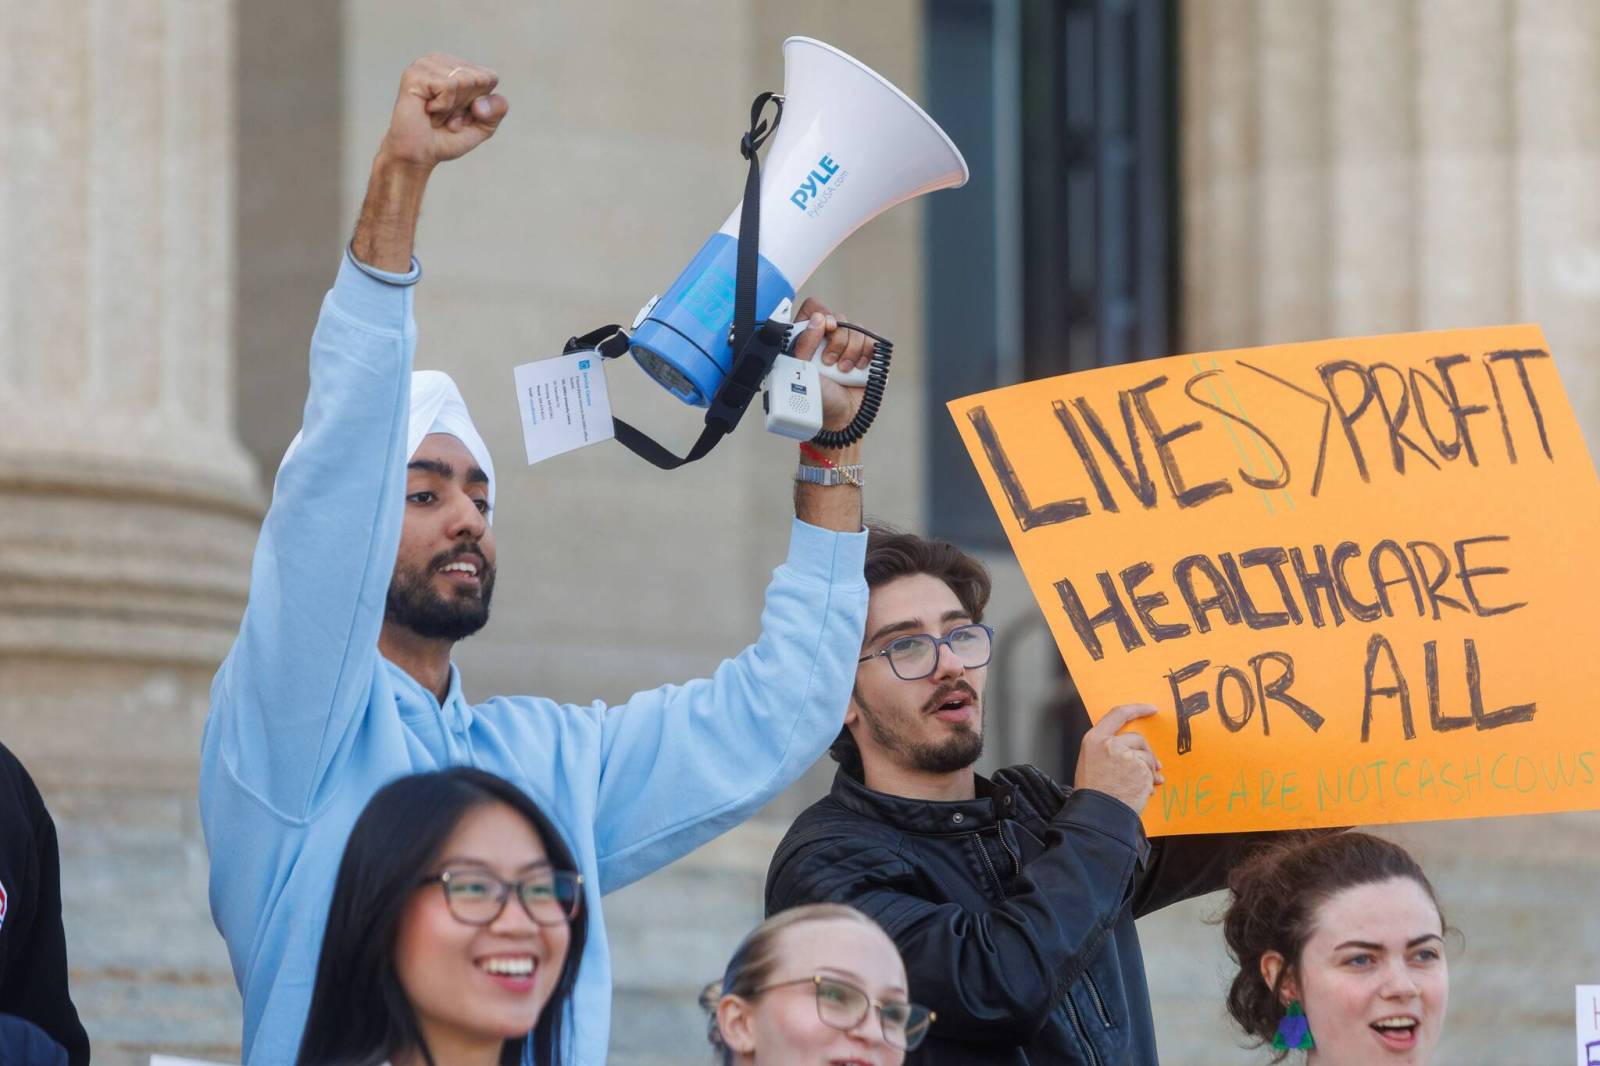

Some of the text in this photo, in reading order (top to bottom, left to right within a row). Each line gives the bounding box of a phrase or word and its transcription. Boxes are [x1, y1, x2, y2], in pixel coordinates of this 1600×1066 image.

[789, 154, 839, 211] PYLE
[1315, 348, 1554, 483] PROFIT
[1053, 535, 1529, 662] HEALTHCARE
[1162, 632, 1536, 756] FOR ALL
[1161, 750, 1596, 822] WE ARE NOT CASH COWS
